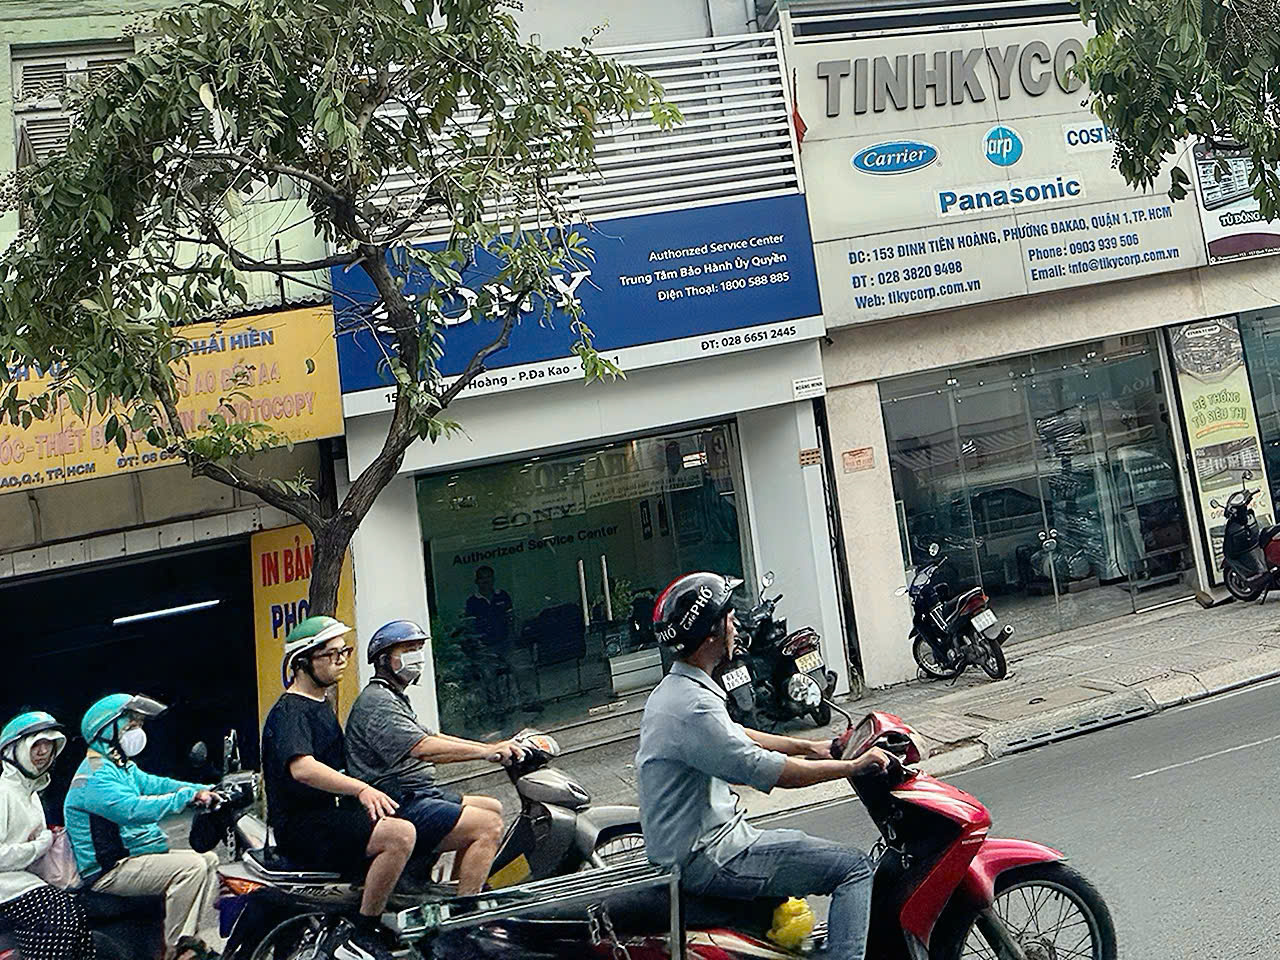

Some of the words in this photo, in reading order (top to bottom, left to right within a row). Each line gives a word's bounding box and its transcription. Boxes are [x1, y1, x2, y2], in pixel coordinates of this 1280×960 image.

[862, 146, 928, 169] Carrier
[939, 177, 1082, 214] Panasonic
[648, 244, 708, 262] Authorized
[709, 239, 748, 253] Service
[749, 234, 784, 248] Center
[872, 247, 895, 261] 153
[897, 241, 927, 258] ĐINH
[928, 235, 955, 254] TIÊN
[1091, 212, 1121, 229] QUẬN
[1148, 206, 1173, 220] HCM
[1028, 244, 1068, 262] Phone:
[1069, 240, 1096, 256] 0903
[1099, 237, 1117, 251] 939
[1119, 233, 1140, 247] 506
[620, 272, 653, 287] Trung
[654, 268, 678, 282] Tâm
[680, 264, 702, 278] Bảo
[704, 260, 732, 274] Hành
[751, 251, 787, 267] Quyền
[877, 271, 901, 285] 028
[902, 265, 932, 281] 3820
[934, 260, 963, 276] 9498
[658, 287, 683, 301] Điện
[685, 282, 719, 297] Thoại:
[720, 279, 746, 291] 1800
[748, 275, 768, 288] 588
[769, 272, 790, 285] 885
[855, 294, 886, 309] Web:
[701, 339, 719, 351] ĐT:
[721, 335, 741, 347] 028
[743, 331, 768, 344] 6651
[769, 326, 797, 339] 2445
[468, 375, 508, 390] Hoàng
[548, 365, 570, 378] Kao
[452, 538, 525, 567] Authorized
[528, 533, 575, 553] Service
[577, 524, 620, 541] Center
[261, 550, 280, 587] IN
